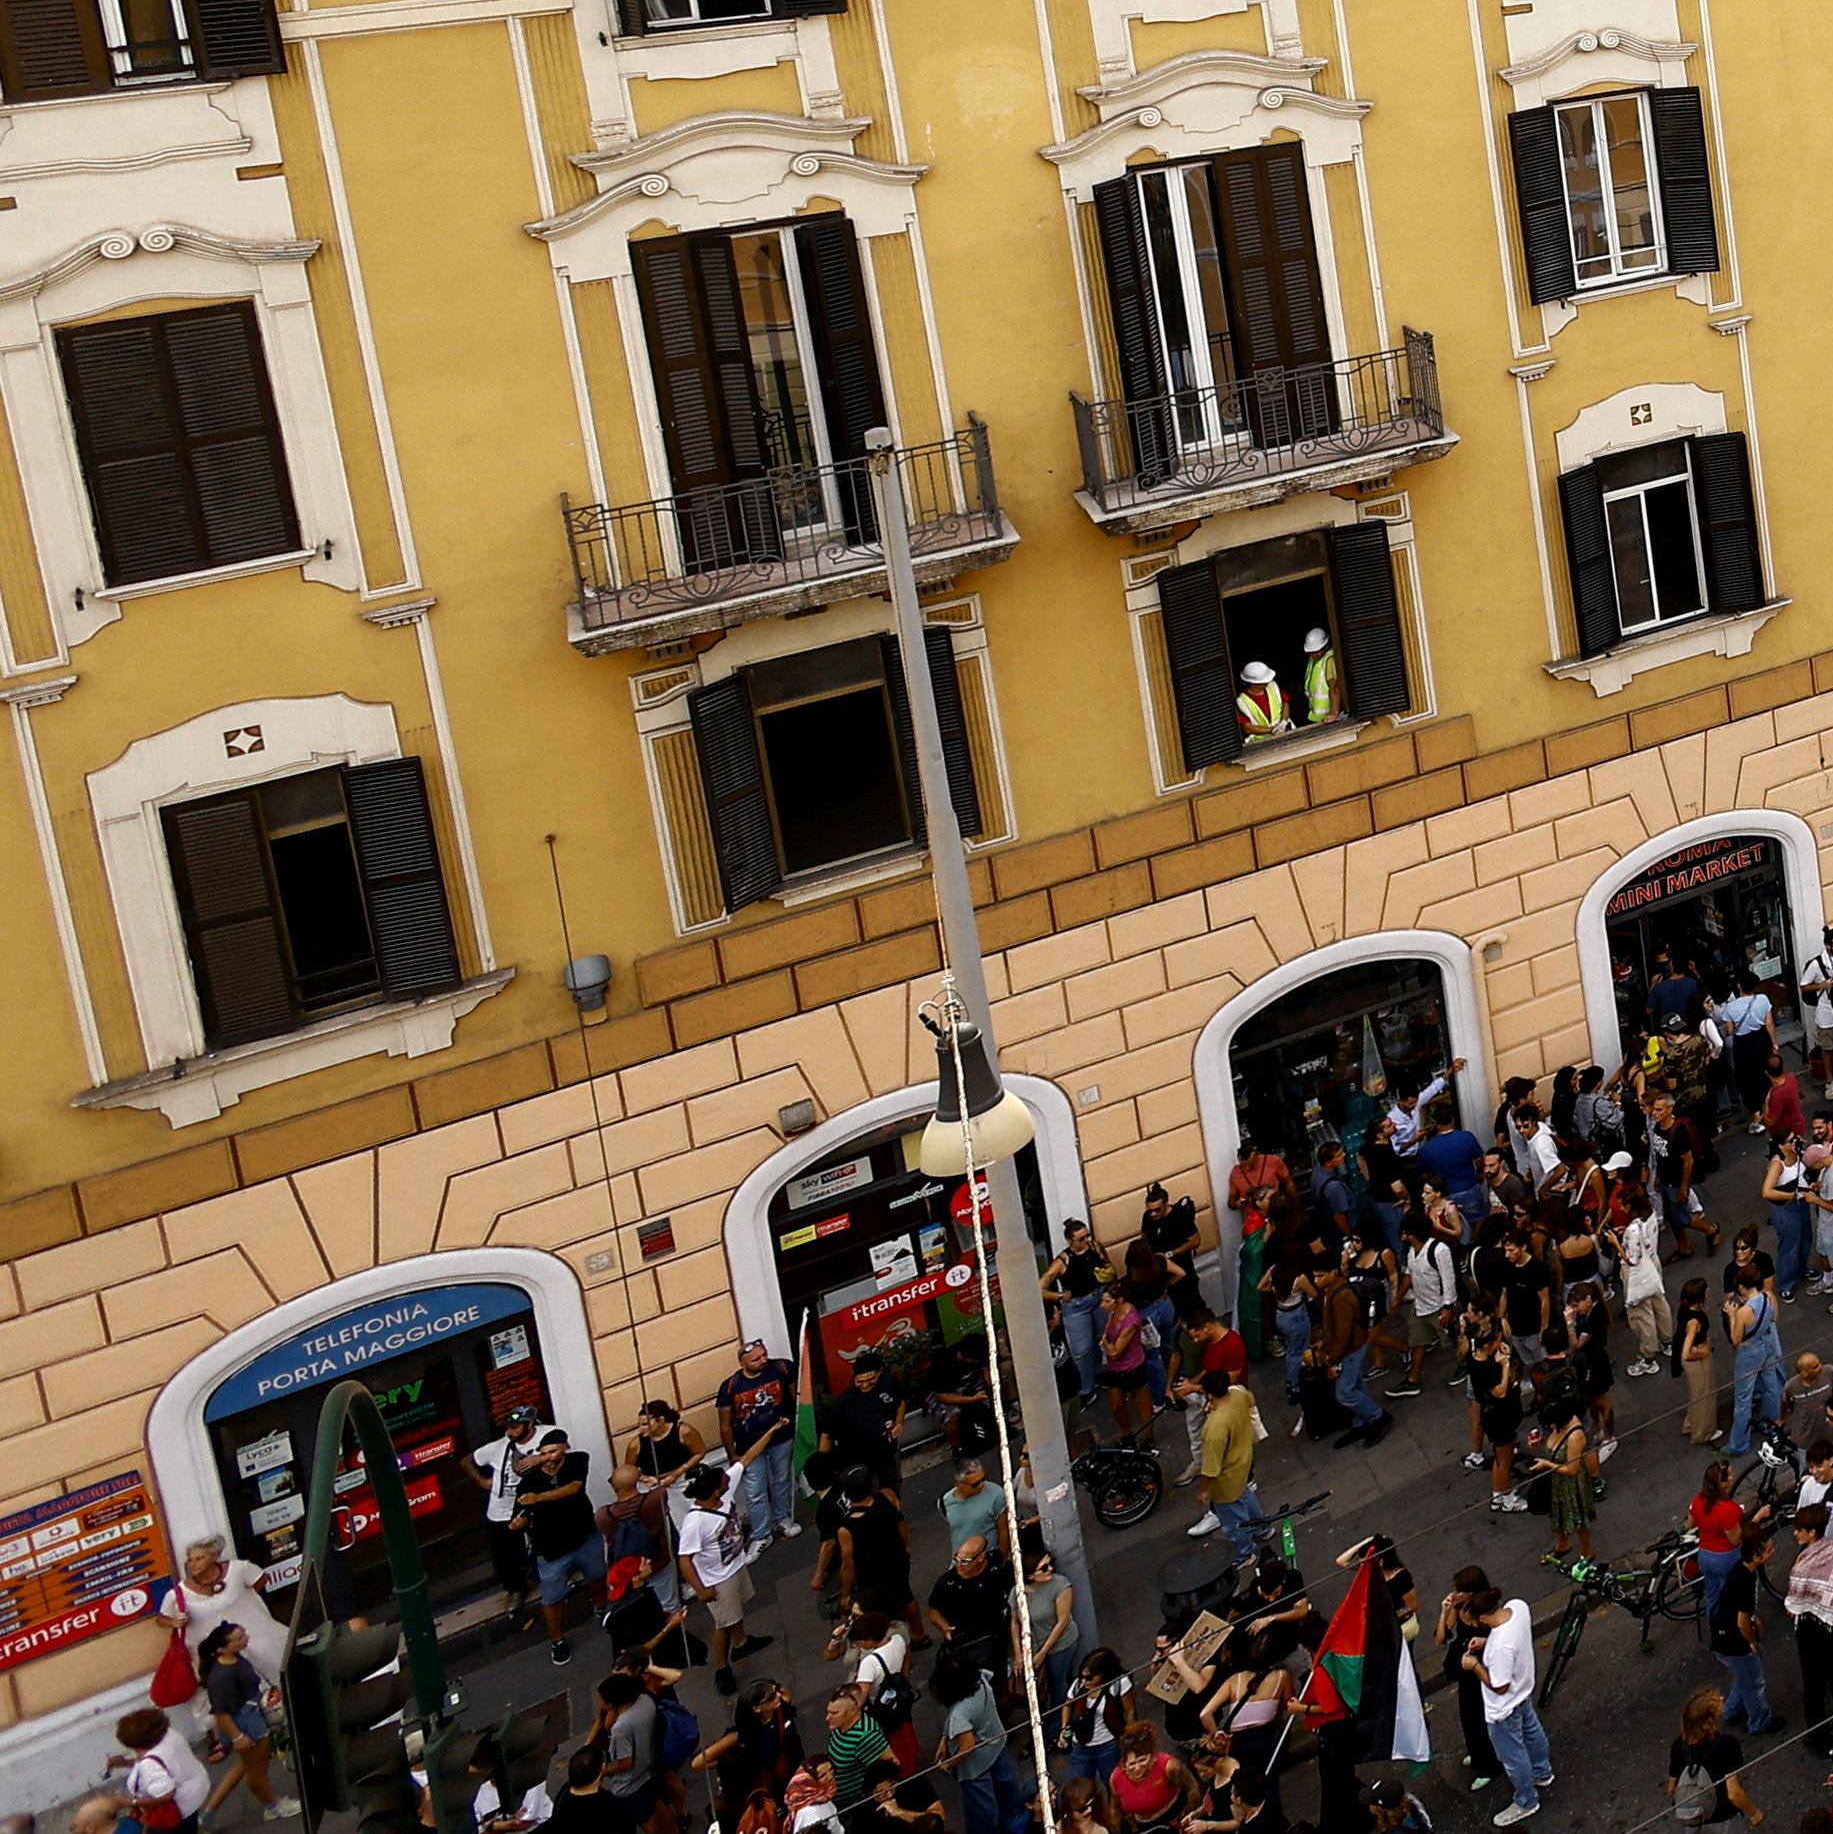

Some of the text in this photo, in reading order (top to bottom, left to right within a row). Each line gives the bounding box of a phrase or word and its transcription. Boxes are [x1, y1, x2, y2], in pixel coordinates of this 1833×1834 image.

[1606, 842, 1765, 917] MINI MARKET
[801, 1177, 820, 1190] sky
[302, 1303, 428, 1356] TELEFONIA
[257, 1305, 481, 1397] PORTA MAGGIORE
[375, 1377, 424, 1410] ery
[85, 1529, 116, 1545] very
[84, 1555, 131, 1578] SCANSIONE
